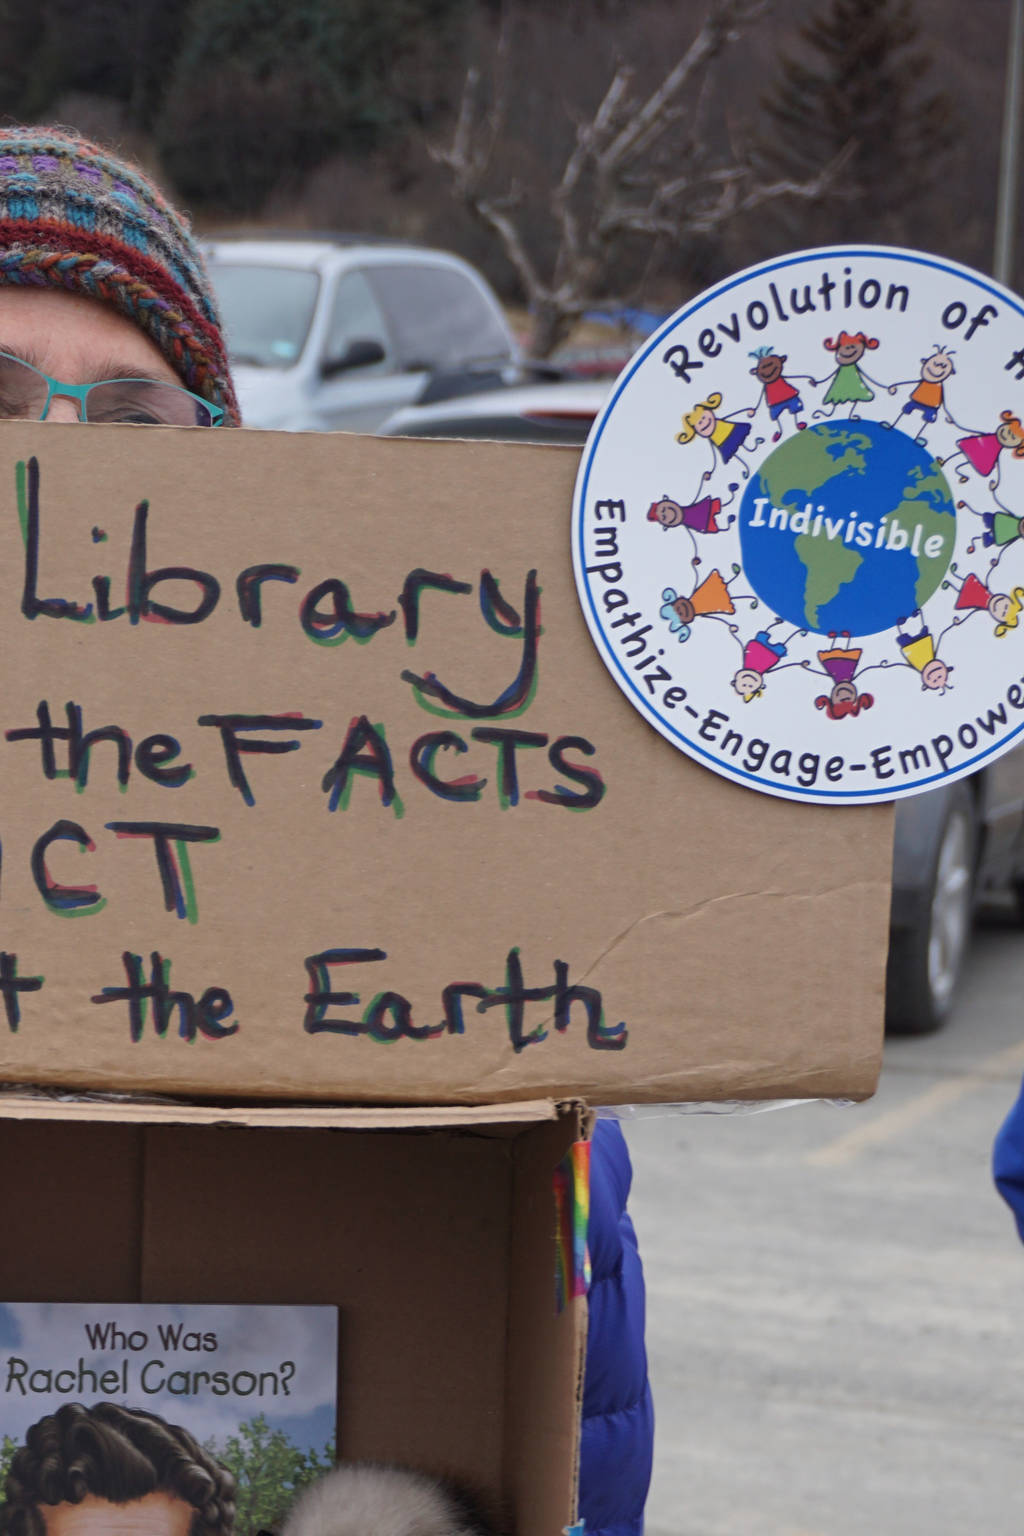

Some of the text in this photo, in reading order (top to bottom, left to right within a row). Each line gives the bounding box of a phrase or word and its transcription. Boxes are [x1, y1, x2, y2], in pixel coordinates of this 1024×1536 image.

[662, 267, 911, 383] Revolution
[942, 301, 999, 341] of
[747, 497, 945, 558] Indivisible
[15, 456, 543, 720] Library
[5, 700, 196, 793] the
[197, 711, 606, 819] FACTS
[90, 951, 240, 1043] the
[303, 947, 628, 1054] Earth
[5, 1357, 296, 1396] Rachel Carson?
[85, 1322, 218, 1352] Who Was
